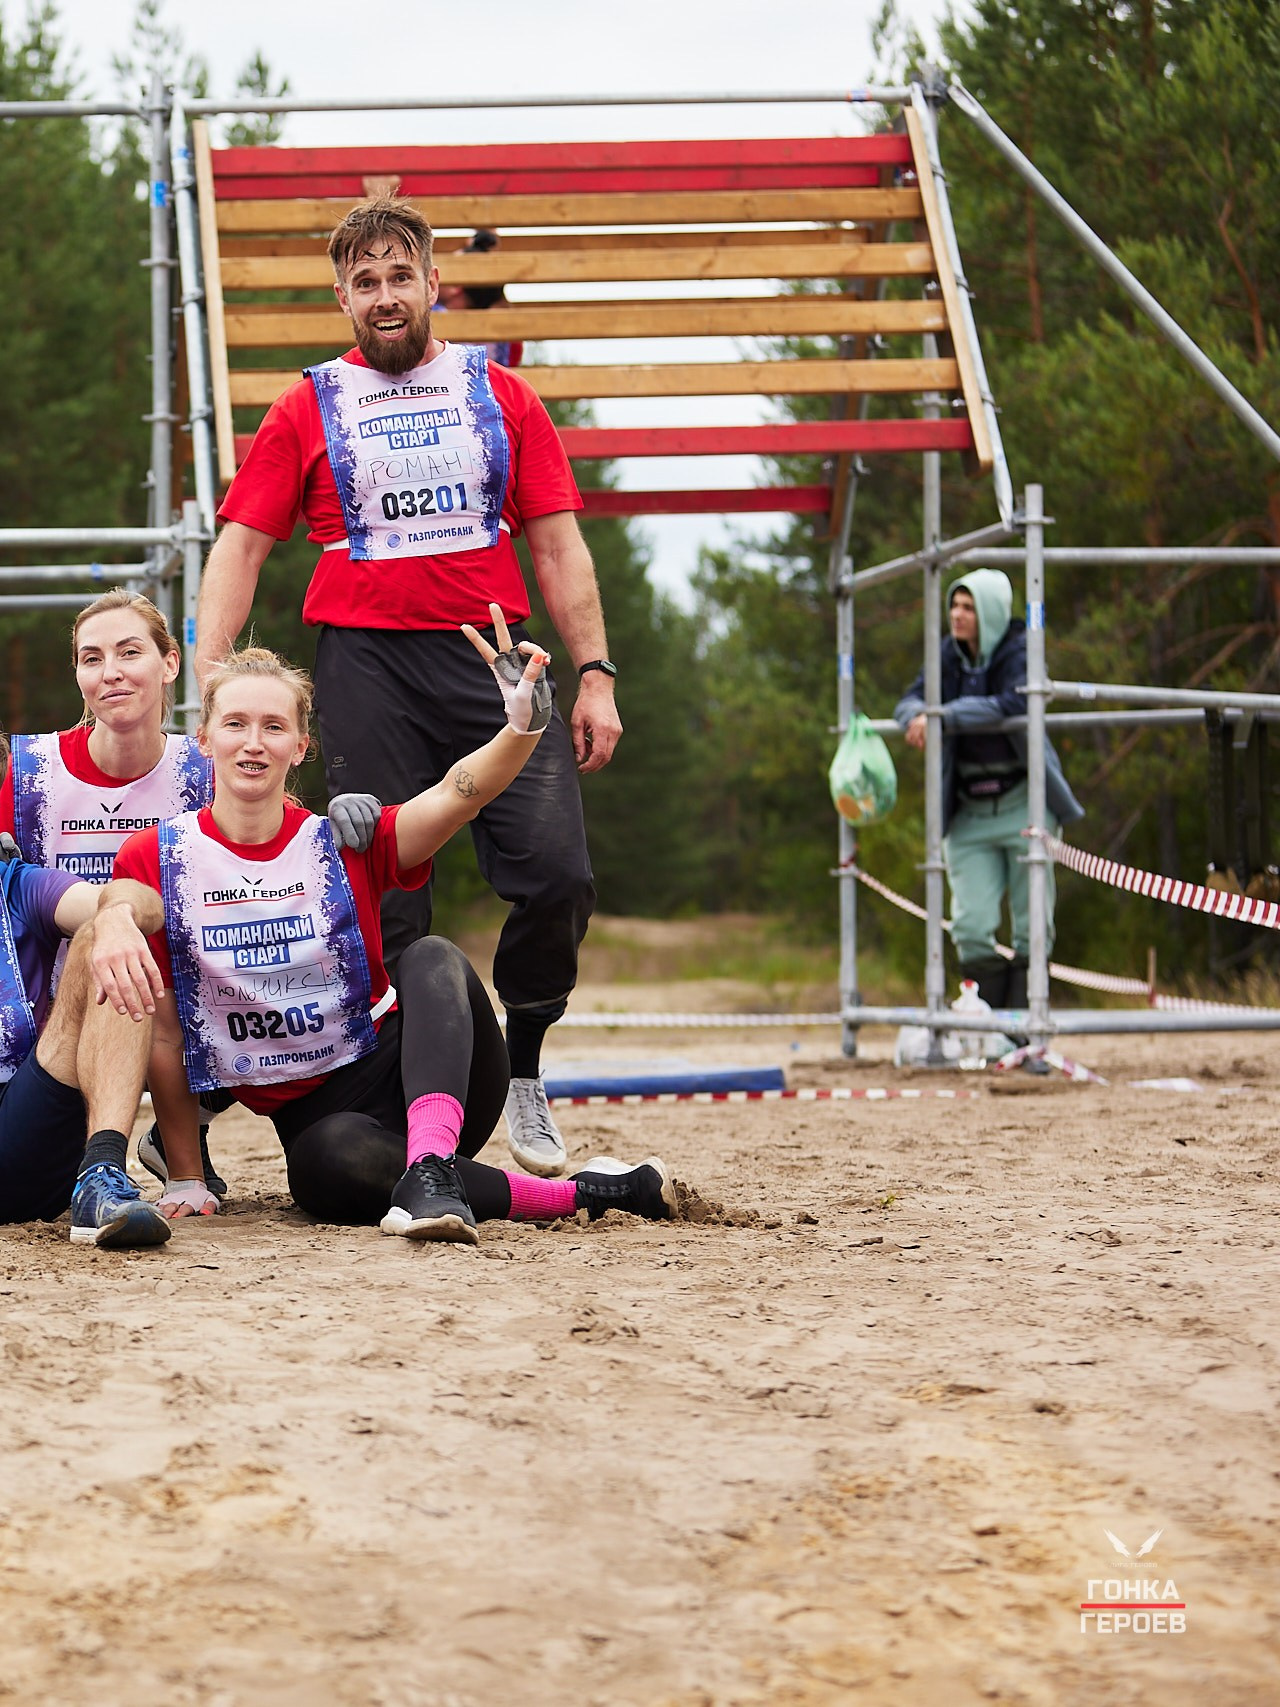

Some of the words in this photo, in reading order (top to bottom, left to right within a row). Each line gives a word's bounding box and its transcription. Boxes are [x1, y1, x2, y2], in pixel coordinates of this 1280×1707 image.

[359, 388, 398, 406] ГОНКА
[402, 386, 450, 396] ГЕРОЕВ
[361, 407, 460, 437] КОМАНДНЫЙ
[390, 429, 436, 449] СТАРТ
[369, 451, 462, 485] РОМАН
[381, 482, 468, 521] 03201
[408, 525, 474, 543] ГАЗПРОМБАНК
[61, 819, 108, 831] ГОНКА
[58, 856, 114, 875] КОМАН
[203, 888, 248, 902] ГОНКА
[252, 882, 305, 898] ГЕРОЕВ
[204, 914, 313, 948] КОМАНДНЫЙ
[235, 943, 286, 966] СТАРТ
[226, 1002, 324, 1042] 03205
[259, 1044, 335, 1068] ГАЗПРОМБАНК
